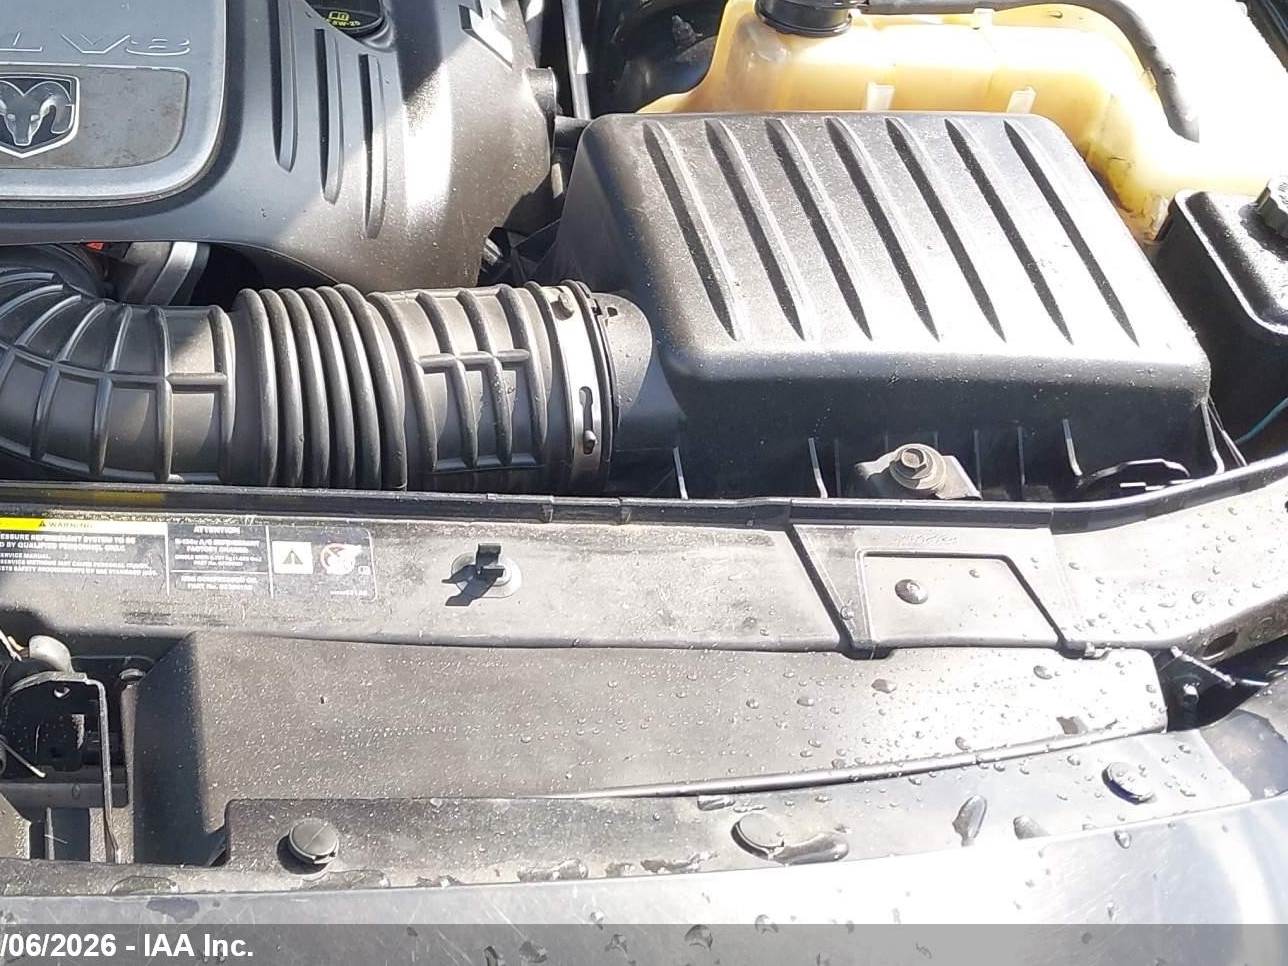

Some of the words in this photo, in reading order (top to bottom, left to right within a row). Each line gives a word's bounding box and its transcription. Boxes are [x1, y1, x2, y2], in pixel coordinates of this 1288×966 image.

[61, 32, 191, 56] V8
[193, 526, 240, 535] ATTENTION
[6, 541, 16, 549] BY
[17, 542, 57, 551] QUALIFIED
[0, 558, 26, 566] SERVICE
